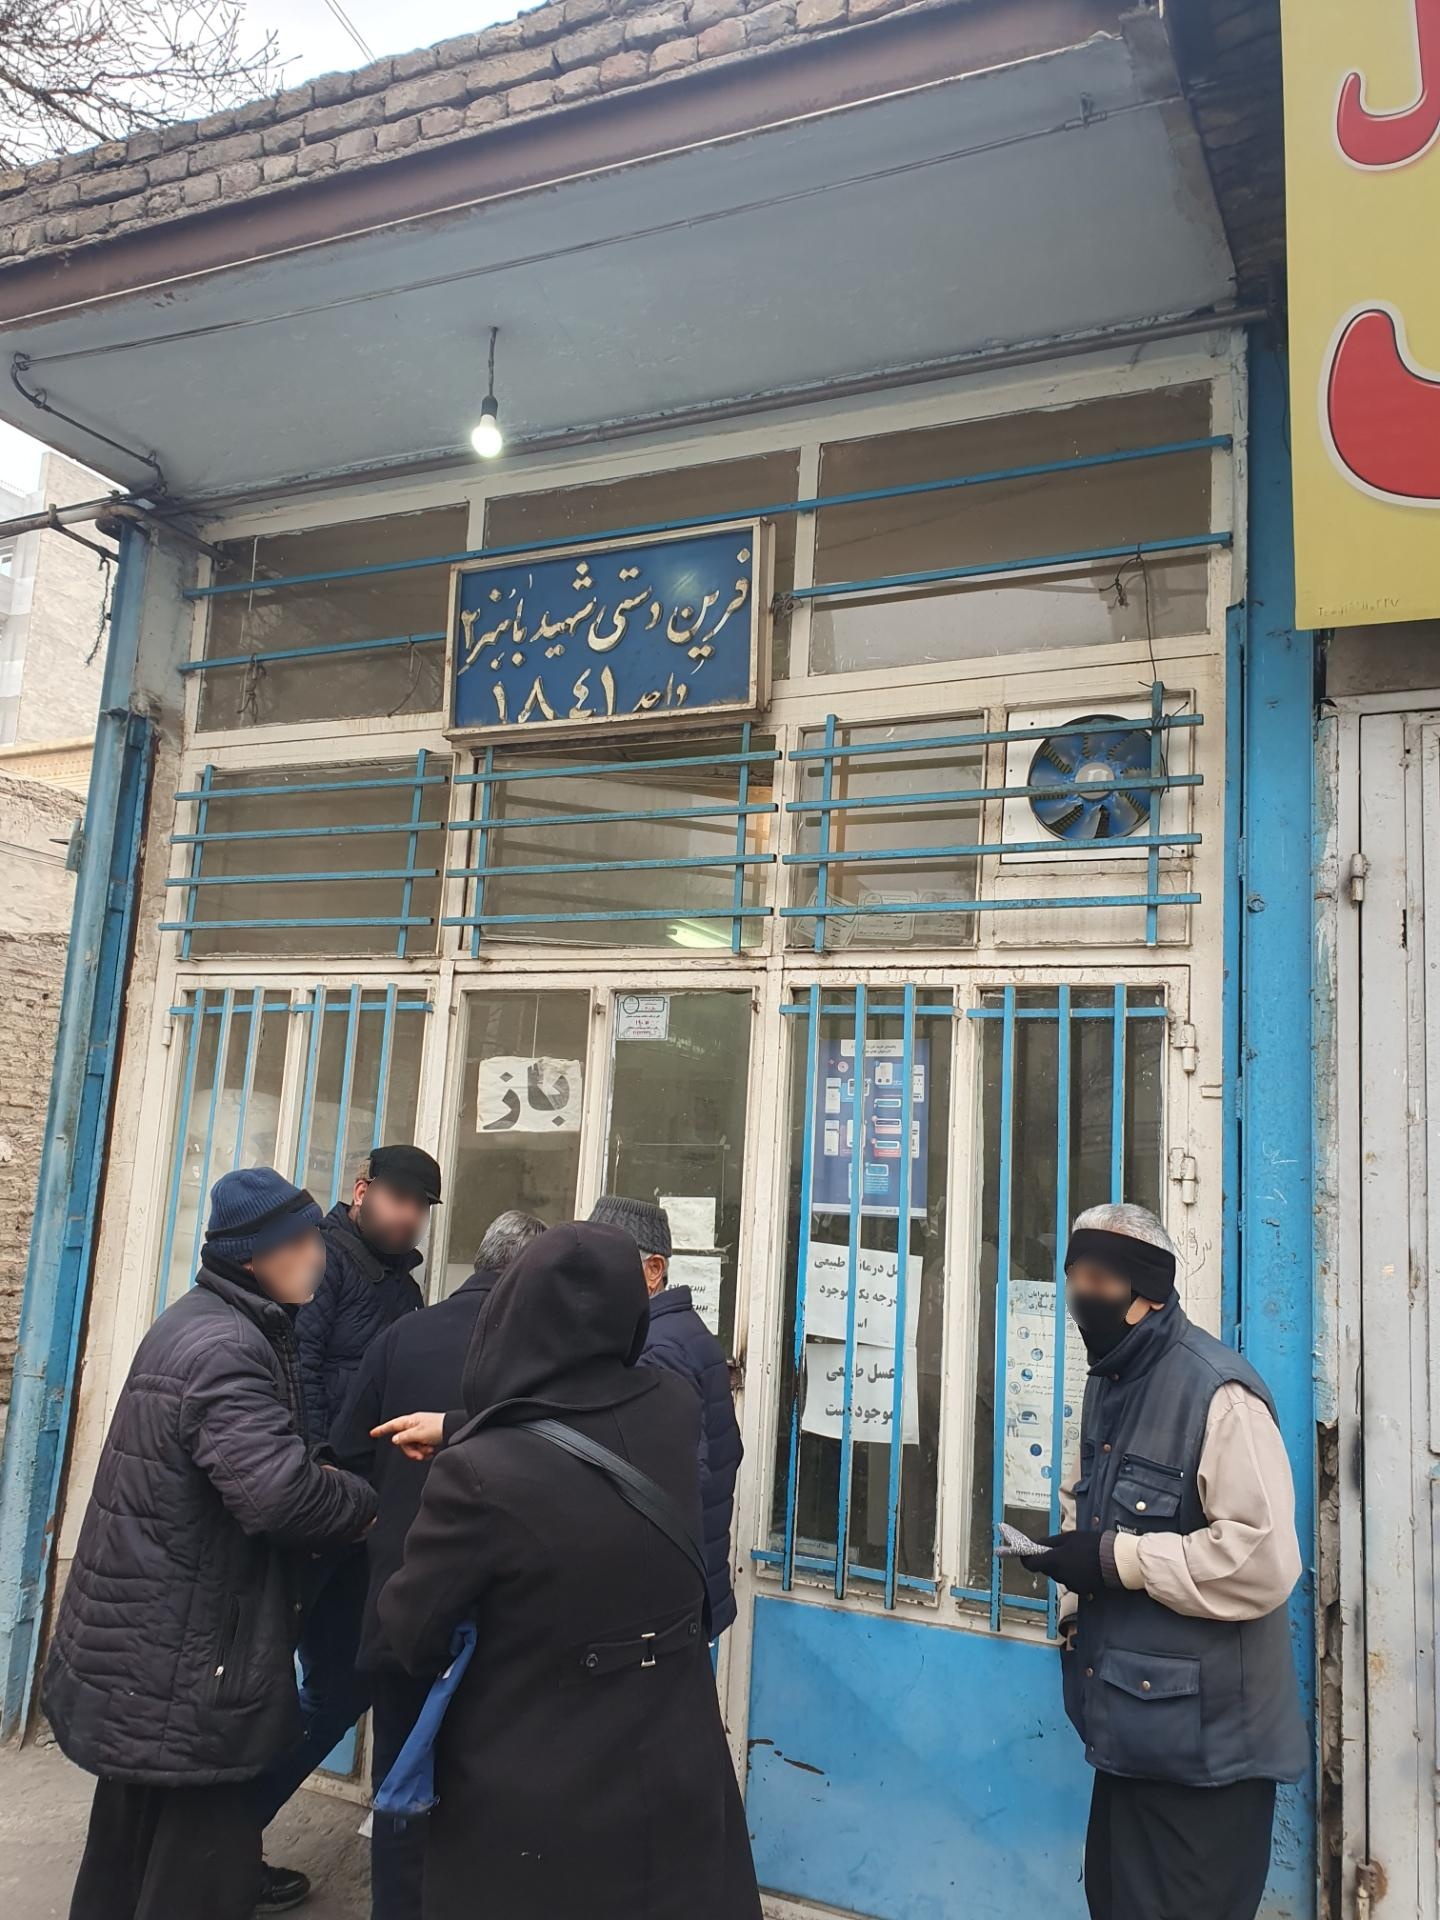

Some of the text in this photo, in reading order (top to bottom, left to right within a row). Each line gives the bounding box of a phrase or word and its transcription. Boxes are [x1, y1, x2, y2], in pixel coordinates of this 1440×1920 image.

[529, 560, 597, 658] شهید
[587, 566, 663, 652] دستی
[632, 672, 687, 713] واحد
[482, 1058, 570, 1131] باز
[814, 1256, 846, 1271] طبیعی
[857, 1318, 868, 1328] اس
[867, 1363, 895, 1384] عسل
[854, 1405, 893, 1425] موجود
